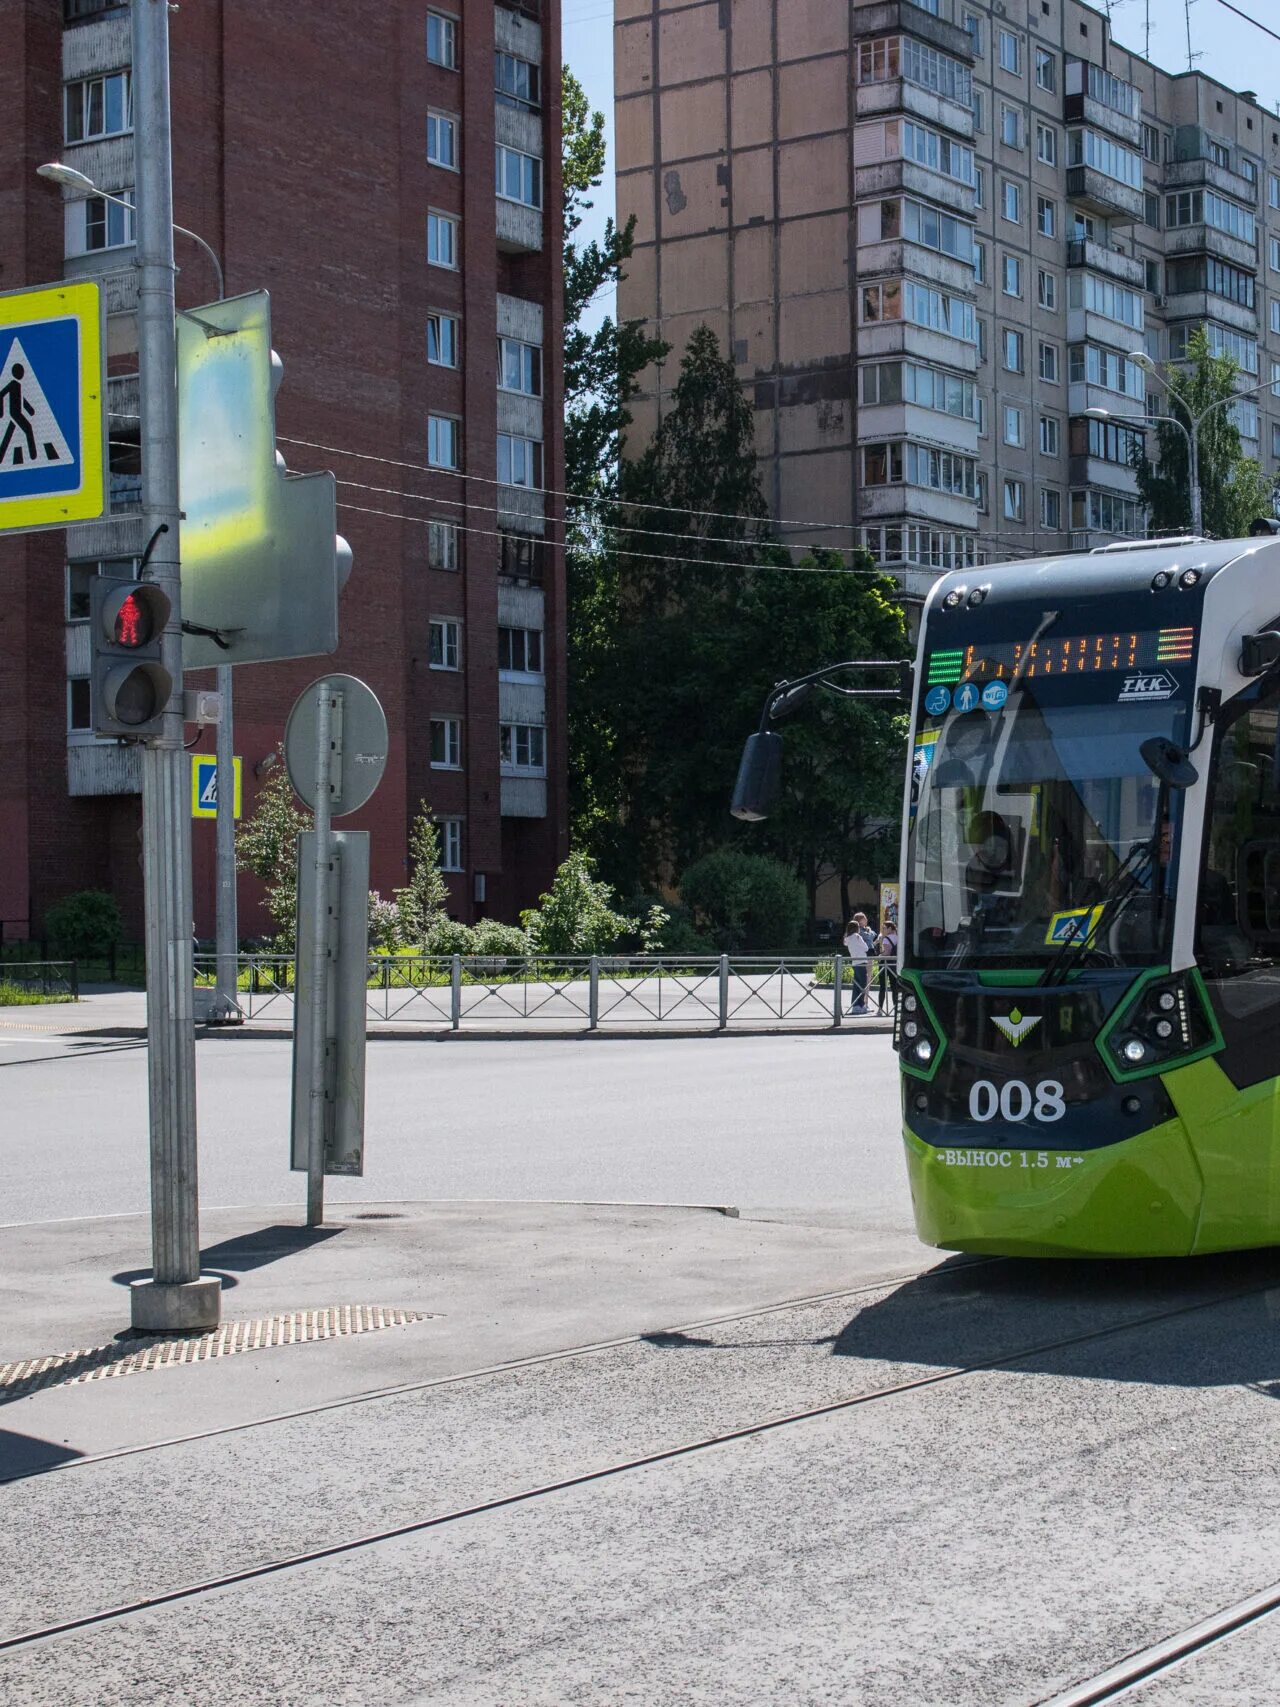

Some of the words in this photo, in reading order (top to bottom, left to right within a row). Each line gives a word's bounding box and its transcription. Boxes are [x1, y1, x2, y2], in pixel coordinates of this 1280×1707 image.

[968, 1079, 1067, 1122] 008
[945, 1150, 1012, 1167] ВЫНОС
[1019, 1152, 1049, 1168] 1.5
